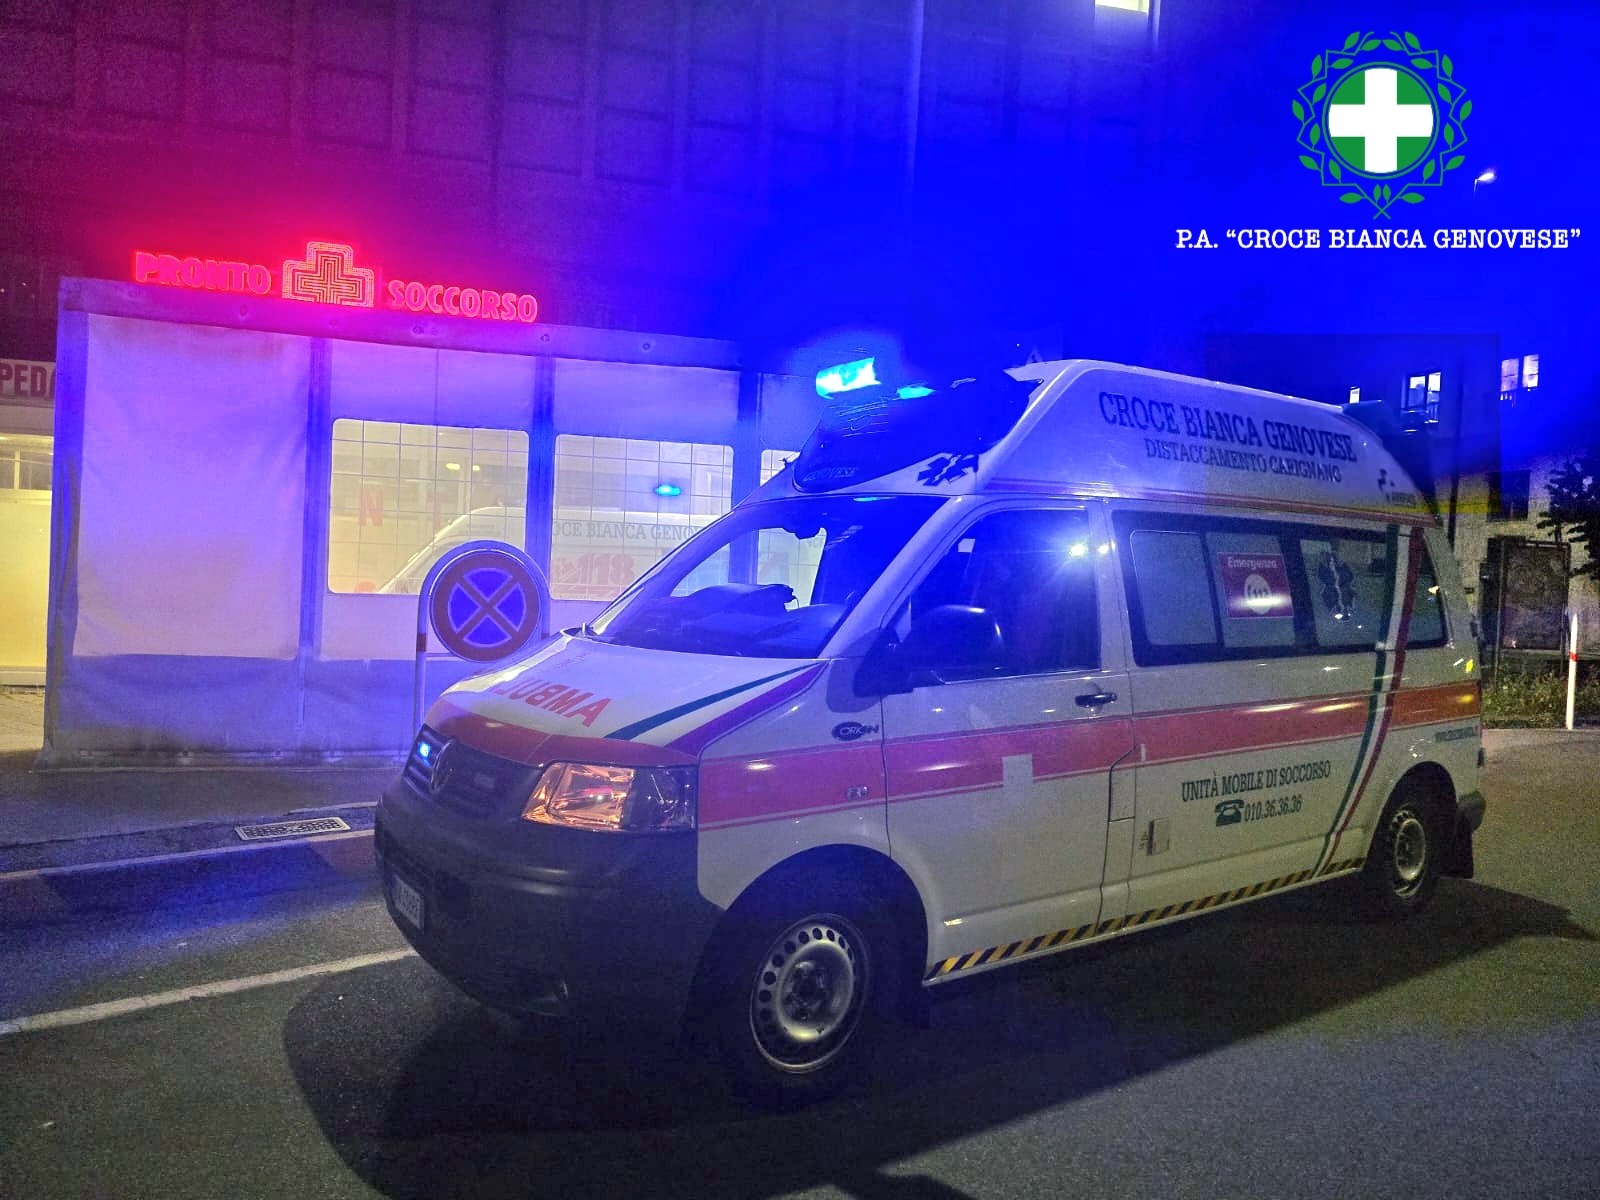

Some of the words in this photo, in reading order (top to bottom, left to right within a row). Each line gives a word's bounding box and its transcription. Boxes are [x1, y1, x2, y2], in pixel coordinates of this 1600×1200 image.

[134, 251, 272, 295] PRONTO
[387, 279, 539, 323] SOCCORSO
[0, 362, 56, 398] PED
[1099, 391, 1181, 435] CROCE
[1183, 406, 1262, 448] BIANCA
[1264, 419, 1358, 463] GENOVESE
[1144, 438, 1268, 472] DISTACCAMENTO
[587, 522, 648, 540] BIANCA
[577, 552, 636, 586] 118
[1181, 771, 1219, 802] UNITÀ
[1221, 769, 1265, 796] MOBILE
[1266, 767, 1278, 788] DI
[1279, 760, 1331, 786] SOCCORSO
[1244, 794, 1303, 822] 010.36.36.36
